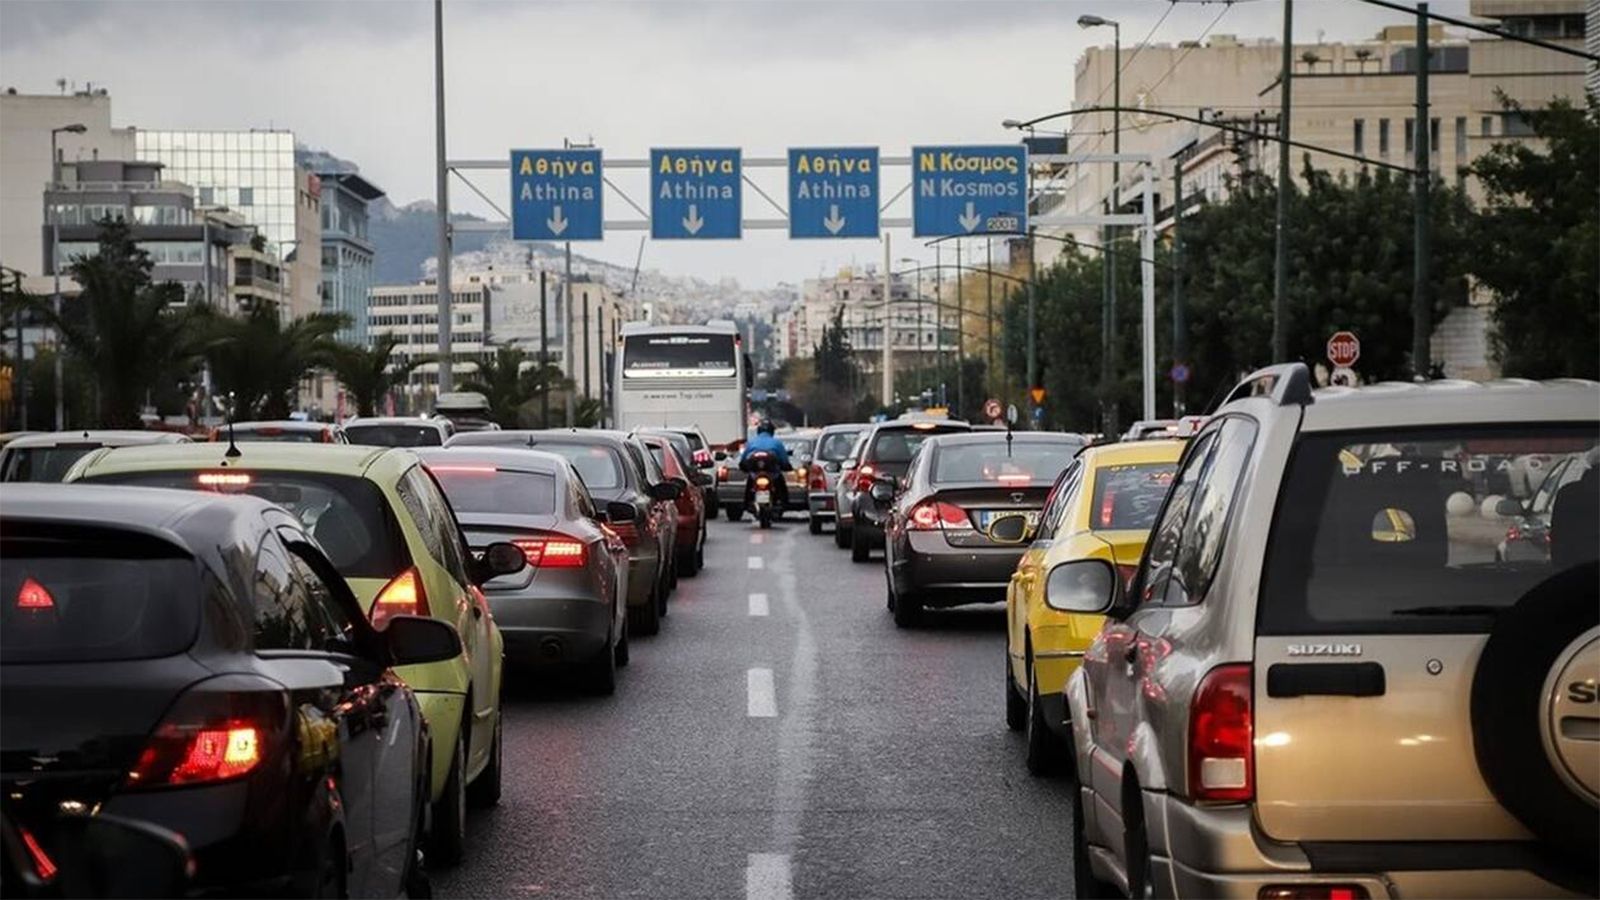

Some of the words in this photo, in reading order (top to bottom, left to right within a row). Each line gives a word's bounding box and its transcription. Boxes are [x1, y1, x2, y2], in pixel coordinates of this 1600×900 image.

[519, 155, 594, 178] Αθήνα
[659, 154, 733, 177] Αθήνα
[797, 153, 871, 177] Αθήνα
[520, 182, 594, 200] Athina
[659, 180, 733, 199] Athina
[797, 180, 871, 199] Athina
[1330, 342, 1357, 359] STOP
[1288, 643, 1363, 656] SUZUKI
